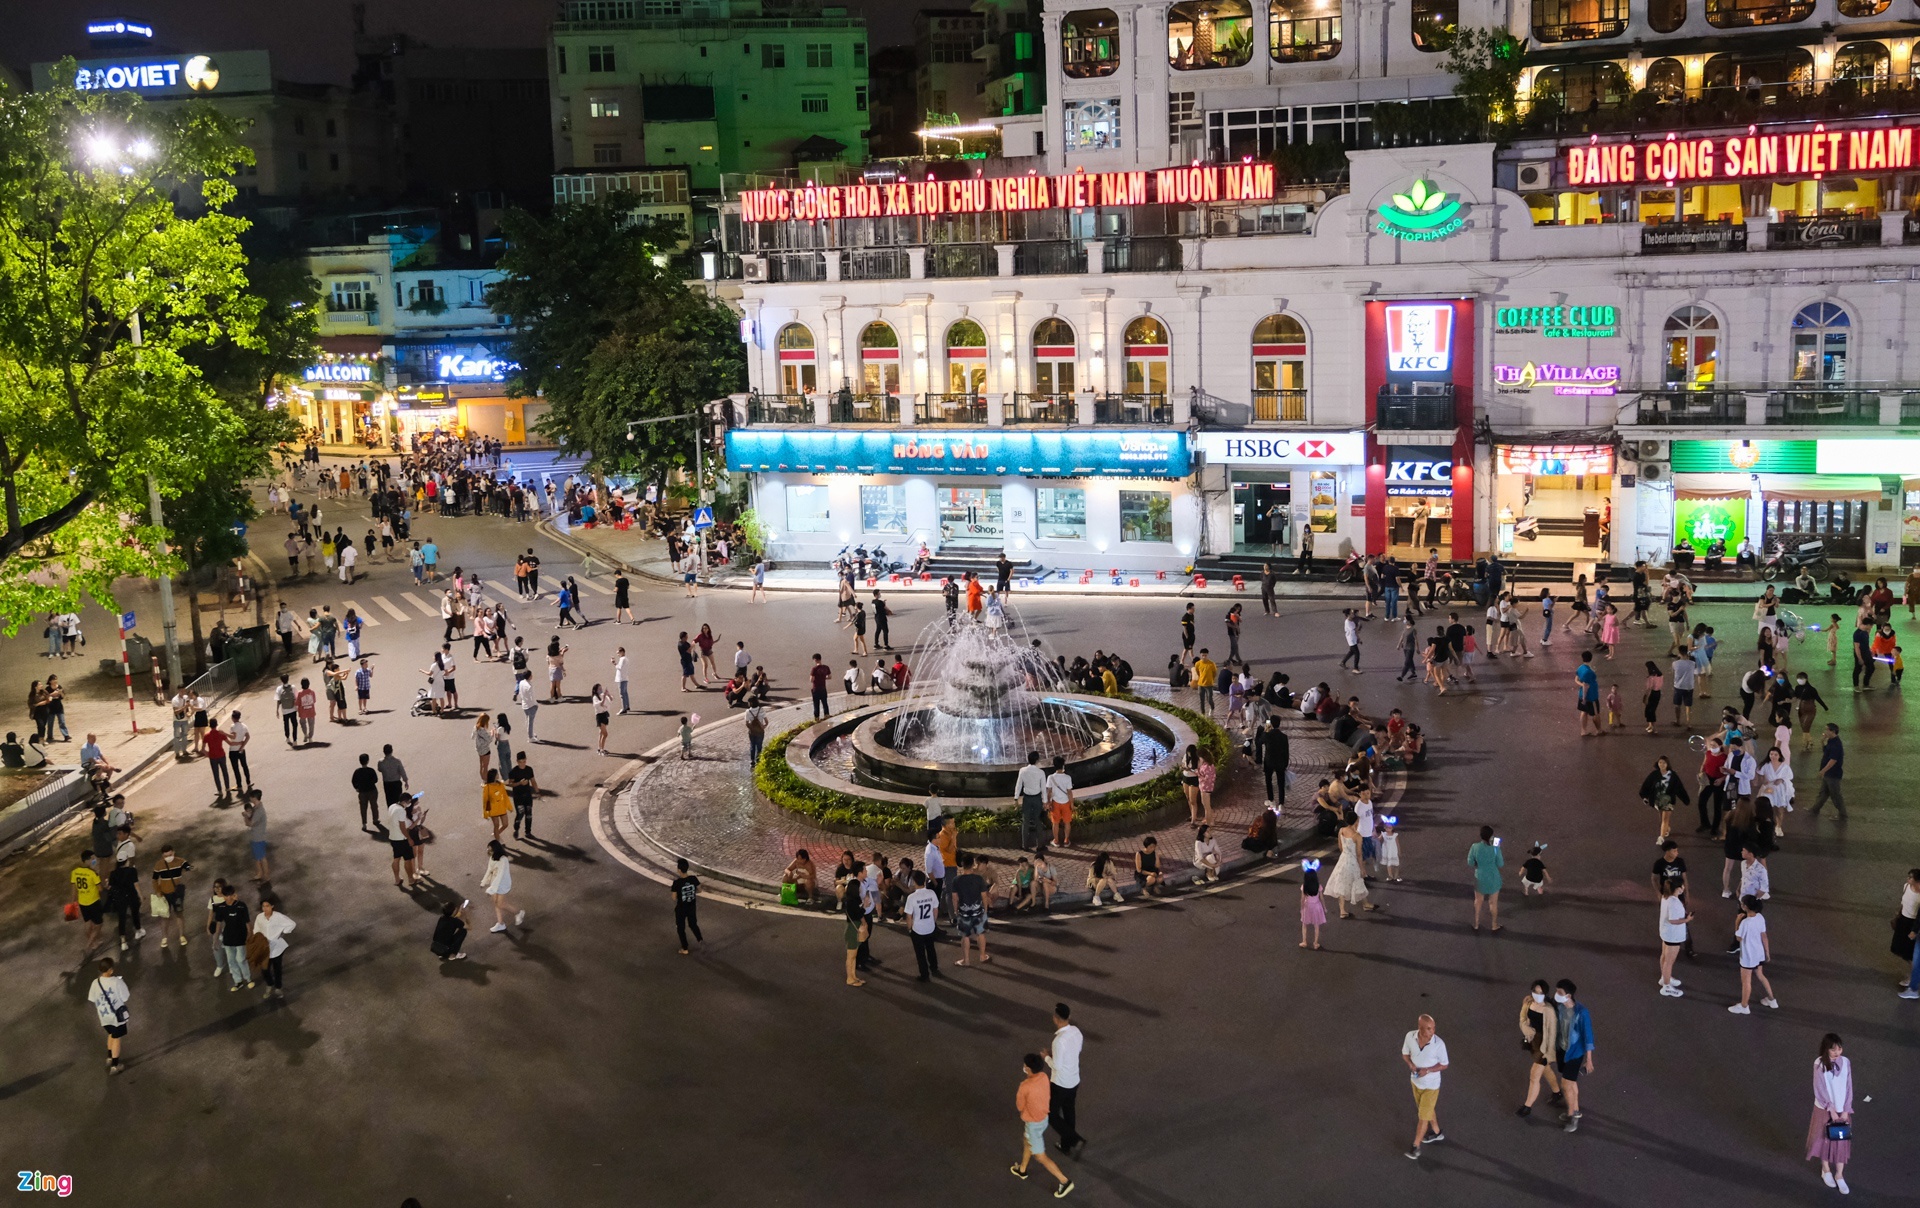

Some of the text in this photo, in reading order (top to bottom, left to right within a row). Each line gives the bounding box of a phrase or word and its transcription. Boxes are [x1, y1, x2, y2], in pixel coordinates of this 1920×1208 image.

[75, 63, 180, 90] BAOVIET
[1568, 123, 1913, 187] ĐẢNG CỘNG SẢN VIỆT NAM
[740, 156, 1273, 226] NƯỚC CỘNG HÒA XÃ HỘI CHỦ NGHĨA VIỆT NAM MUÔN NĂM
[1376, 217, 1463, 242] PHYTOPHARCO
[1644, 232, 1654, 245] The
[1655, 231, 1668, 244] best
[1497, 305, 1616, 328] COFFEE CLUB
[1562, 327, 1570, 338] &
[1571, 326, 1614, 338] Restaurant
[1398, 356, 1439, 369] KFC
[1554, 386, 1614, 395] Restaurants
[1225, 439, 1290, 458] HSBC
[1385, 461, 1452, 480] KFC
[1417, 488, 1453, 497] Kentucky
[76, 876, 88, 890] 86
[918, 903, 932, 920] 12
